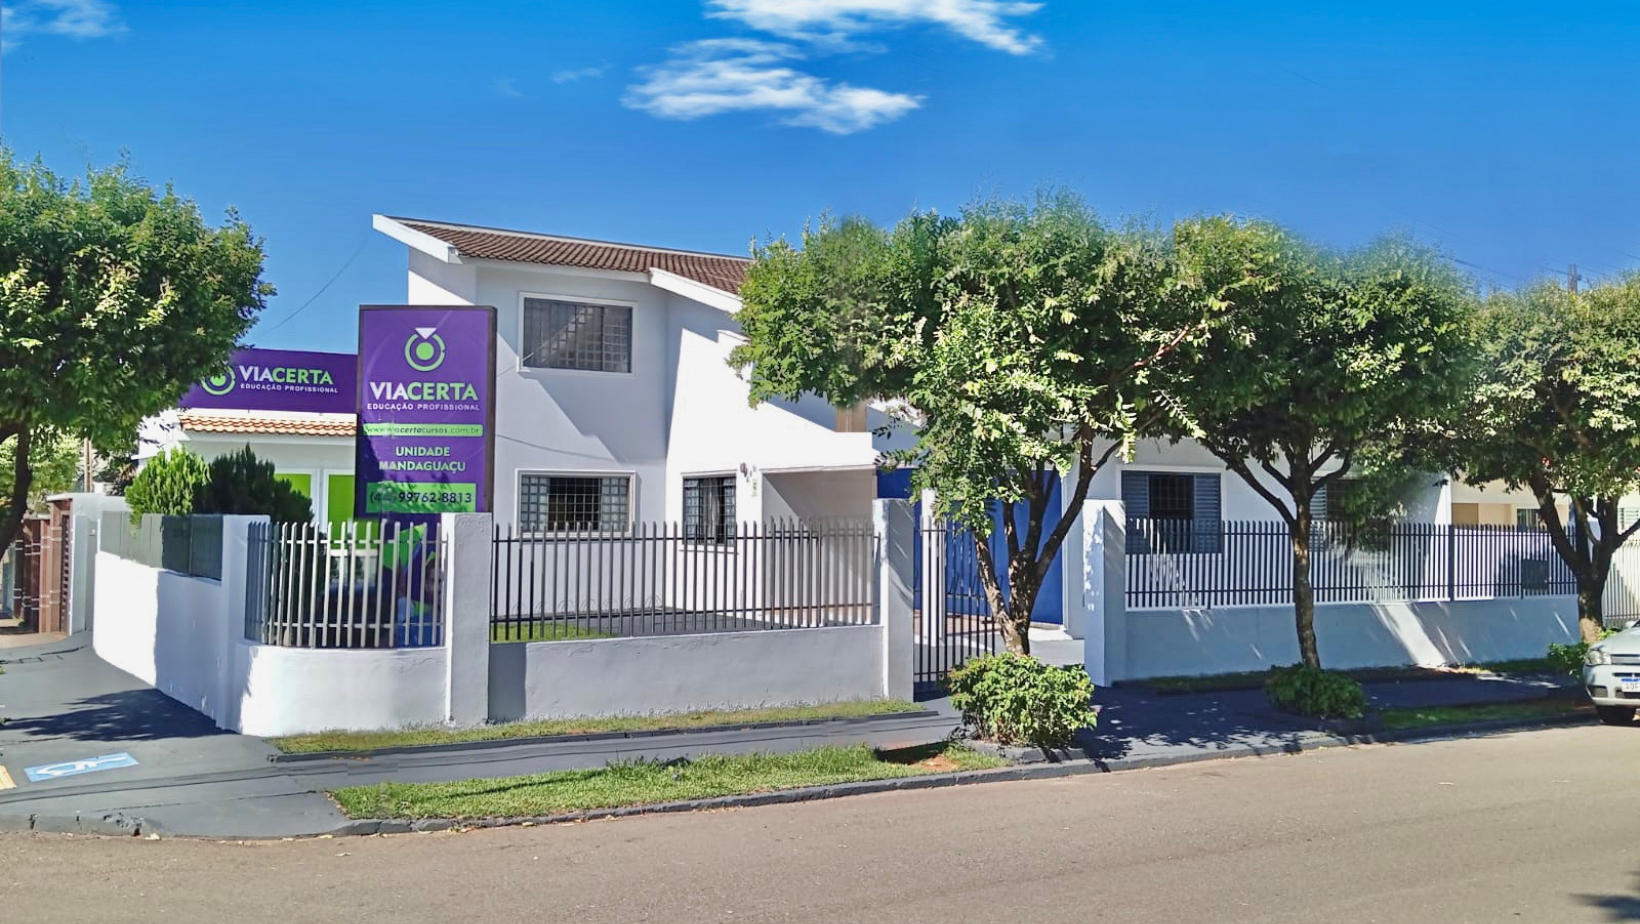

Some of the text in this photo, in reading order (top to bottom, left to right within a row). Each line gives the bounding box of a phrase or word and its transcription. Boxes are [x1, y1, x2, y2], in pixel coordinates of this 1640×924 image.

[239, 365, 334, 385] VIACERTA
[240, 383, 282, 391] EDUCAÇÃO
[369, 382, 479, 401] VIACERTA
[367, 403, 480, 411] EDUCAÇÃO PROFISSIONAL
[395, 446, 451, 457] UNIDADE
[379, 461, 466, 473] MANDAGUAÇU
[398, 492, 472, 503] 99762-8813
